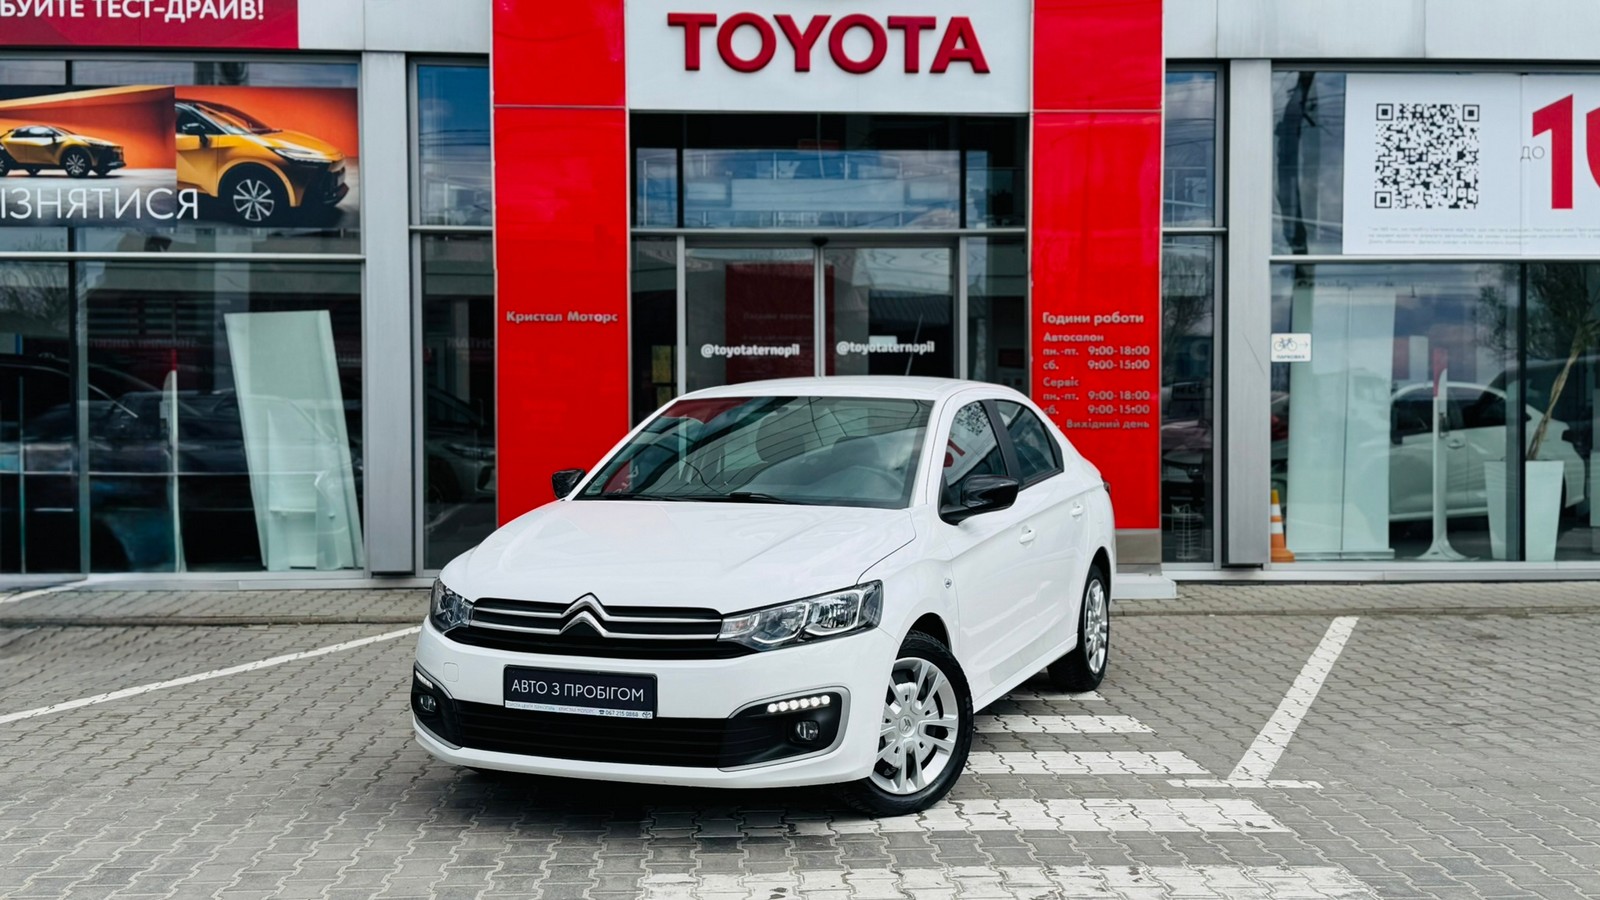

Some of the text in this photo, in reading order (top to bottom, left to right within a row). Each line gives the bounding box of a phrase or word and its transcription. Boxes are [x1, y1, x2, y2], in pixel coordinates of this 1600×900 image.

[667, 12, 991, 74] TOYOTA
[1532, 93, 1600, 210] 1
[0, 187, 199, 220] ІЗНЯТИСЯ
[506, 311, 618, 324] Кристал Моторс
[1042, 311, 1144, 326] Години роботи
[1043, 332, 1104, 342] Автосалон
[701, 344, 800, 358] @toyotaternopil
[836, 340, 935, 356] @toyotaternopil
[1043, 360, 1060, 370] сб.
[1043, 376, 1079, 388] Сервіс
[1066, 418, 1121, 430] Вихідний
[1123, 420, 1150, 430] день
[511, 679, 548, 695] АВТО
[564, 684, 644, 702] ПРОБІГОМ
